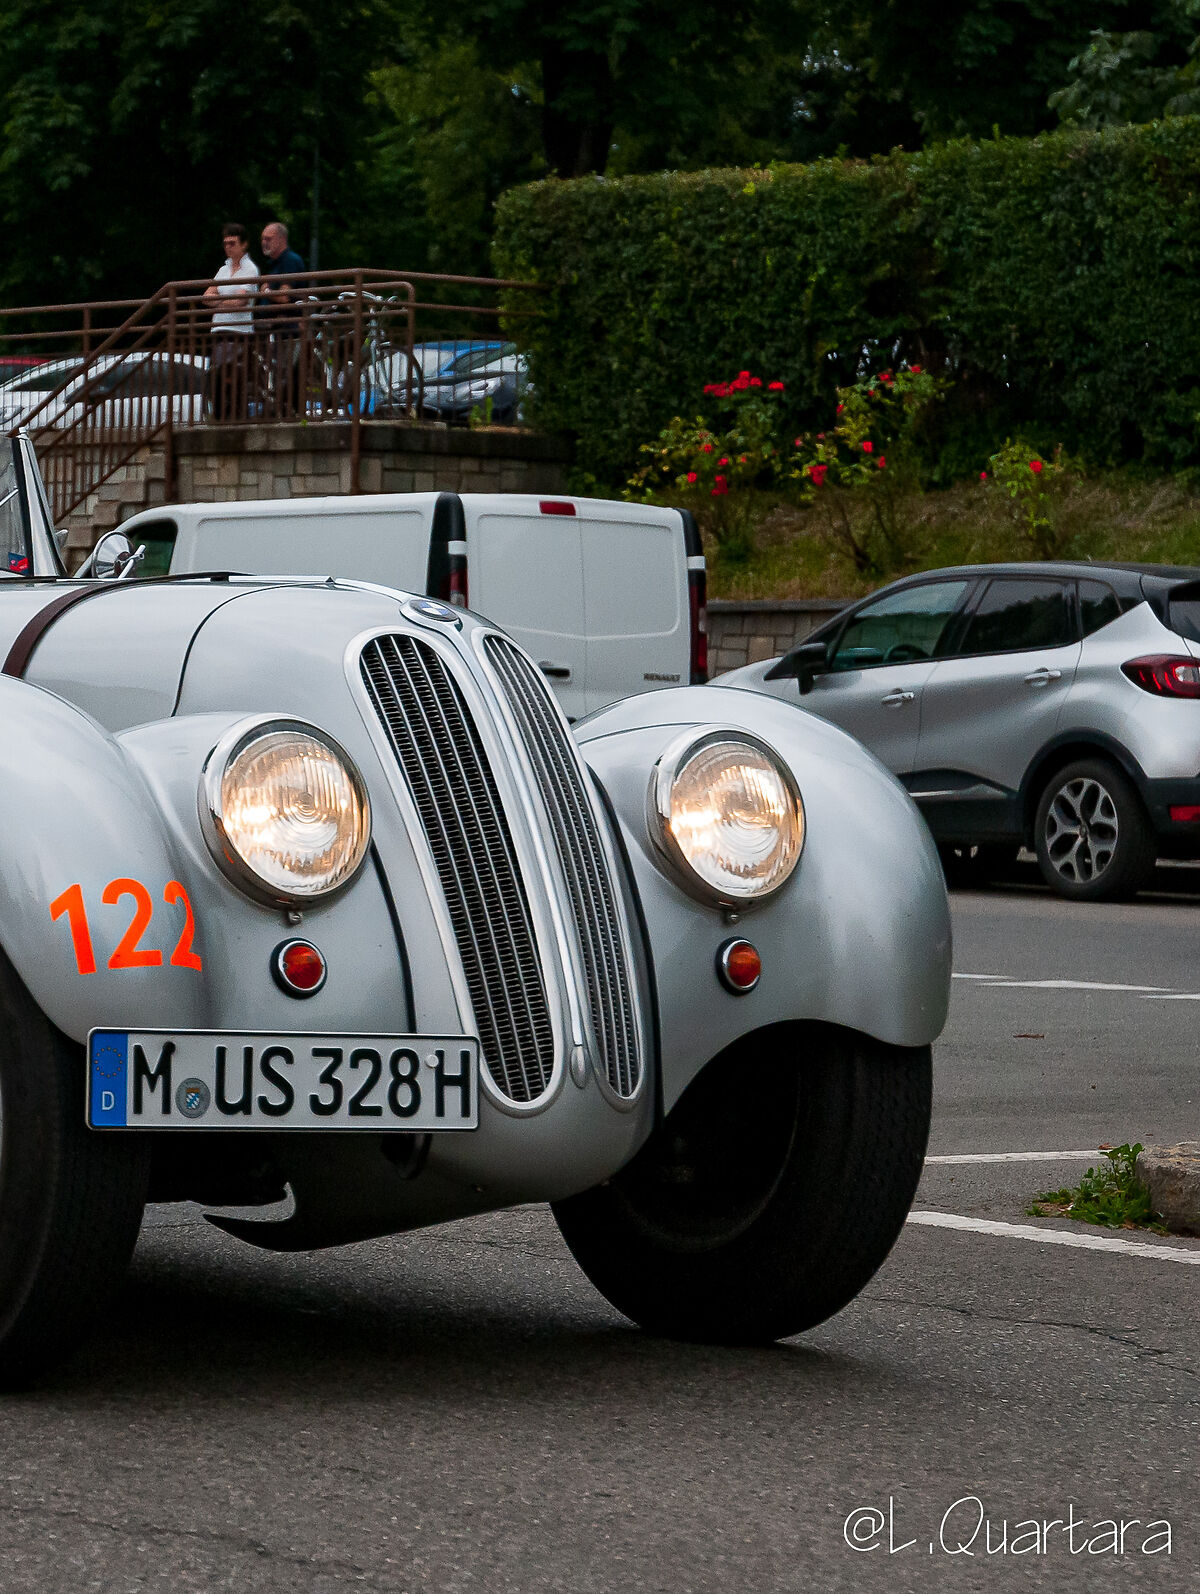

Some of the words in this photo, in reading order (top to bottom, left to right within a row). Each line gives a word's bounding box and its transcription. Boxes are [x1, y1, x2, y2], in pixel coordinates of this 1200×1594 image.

[49, 877, 202, 975] 122
[101, 1091, 115, 1112] D
[132, 1042, 176, 1115] M
[214, 1045, 295, 1116] US
